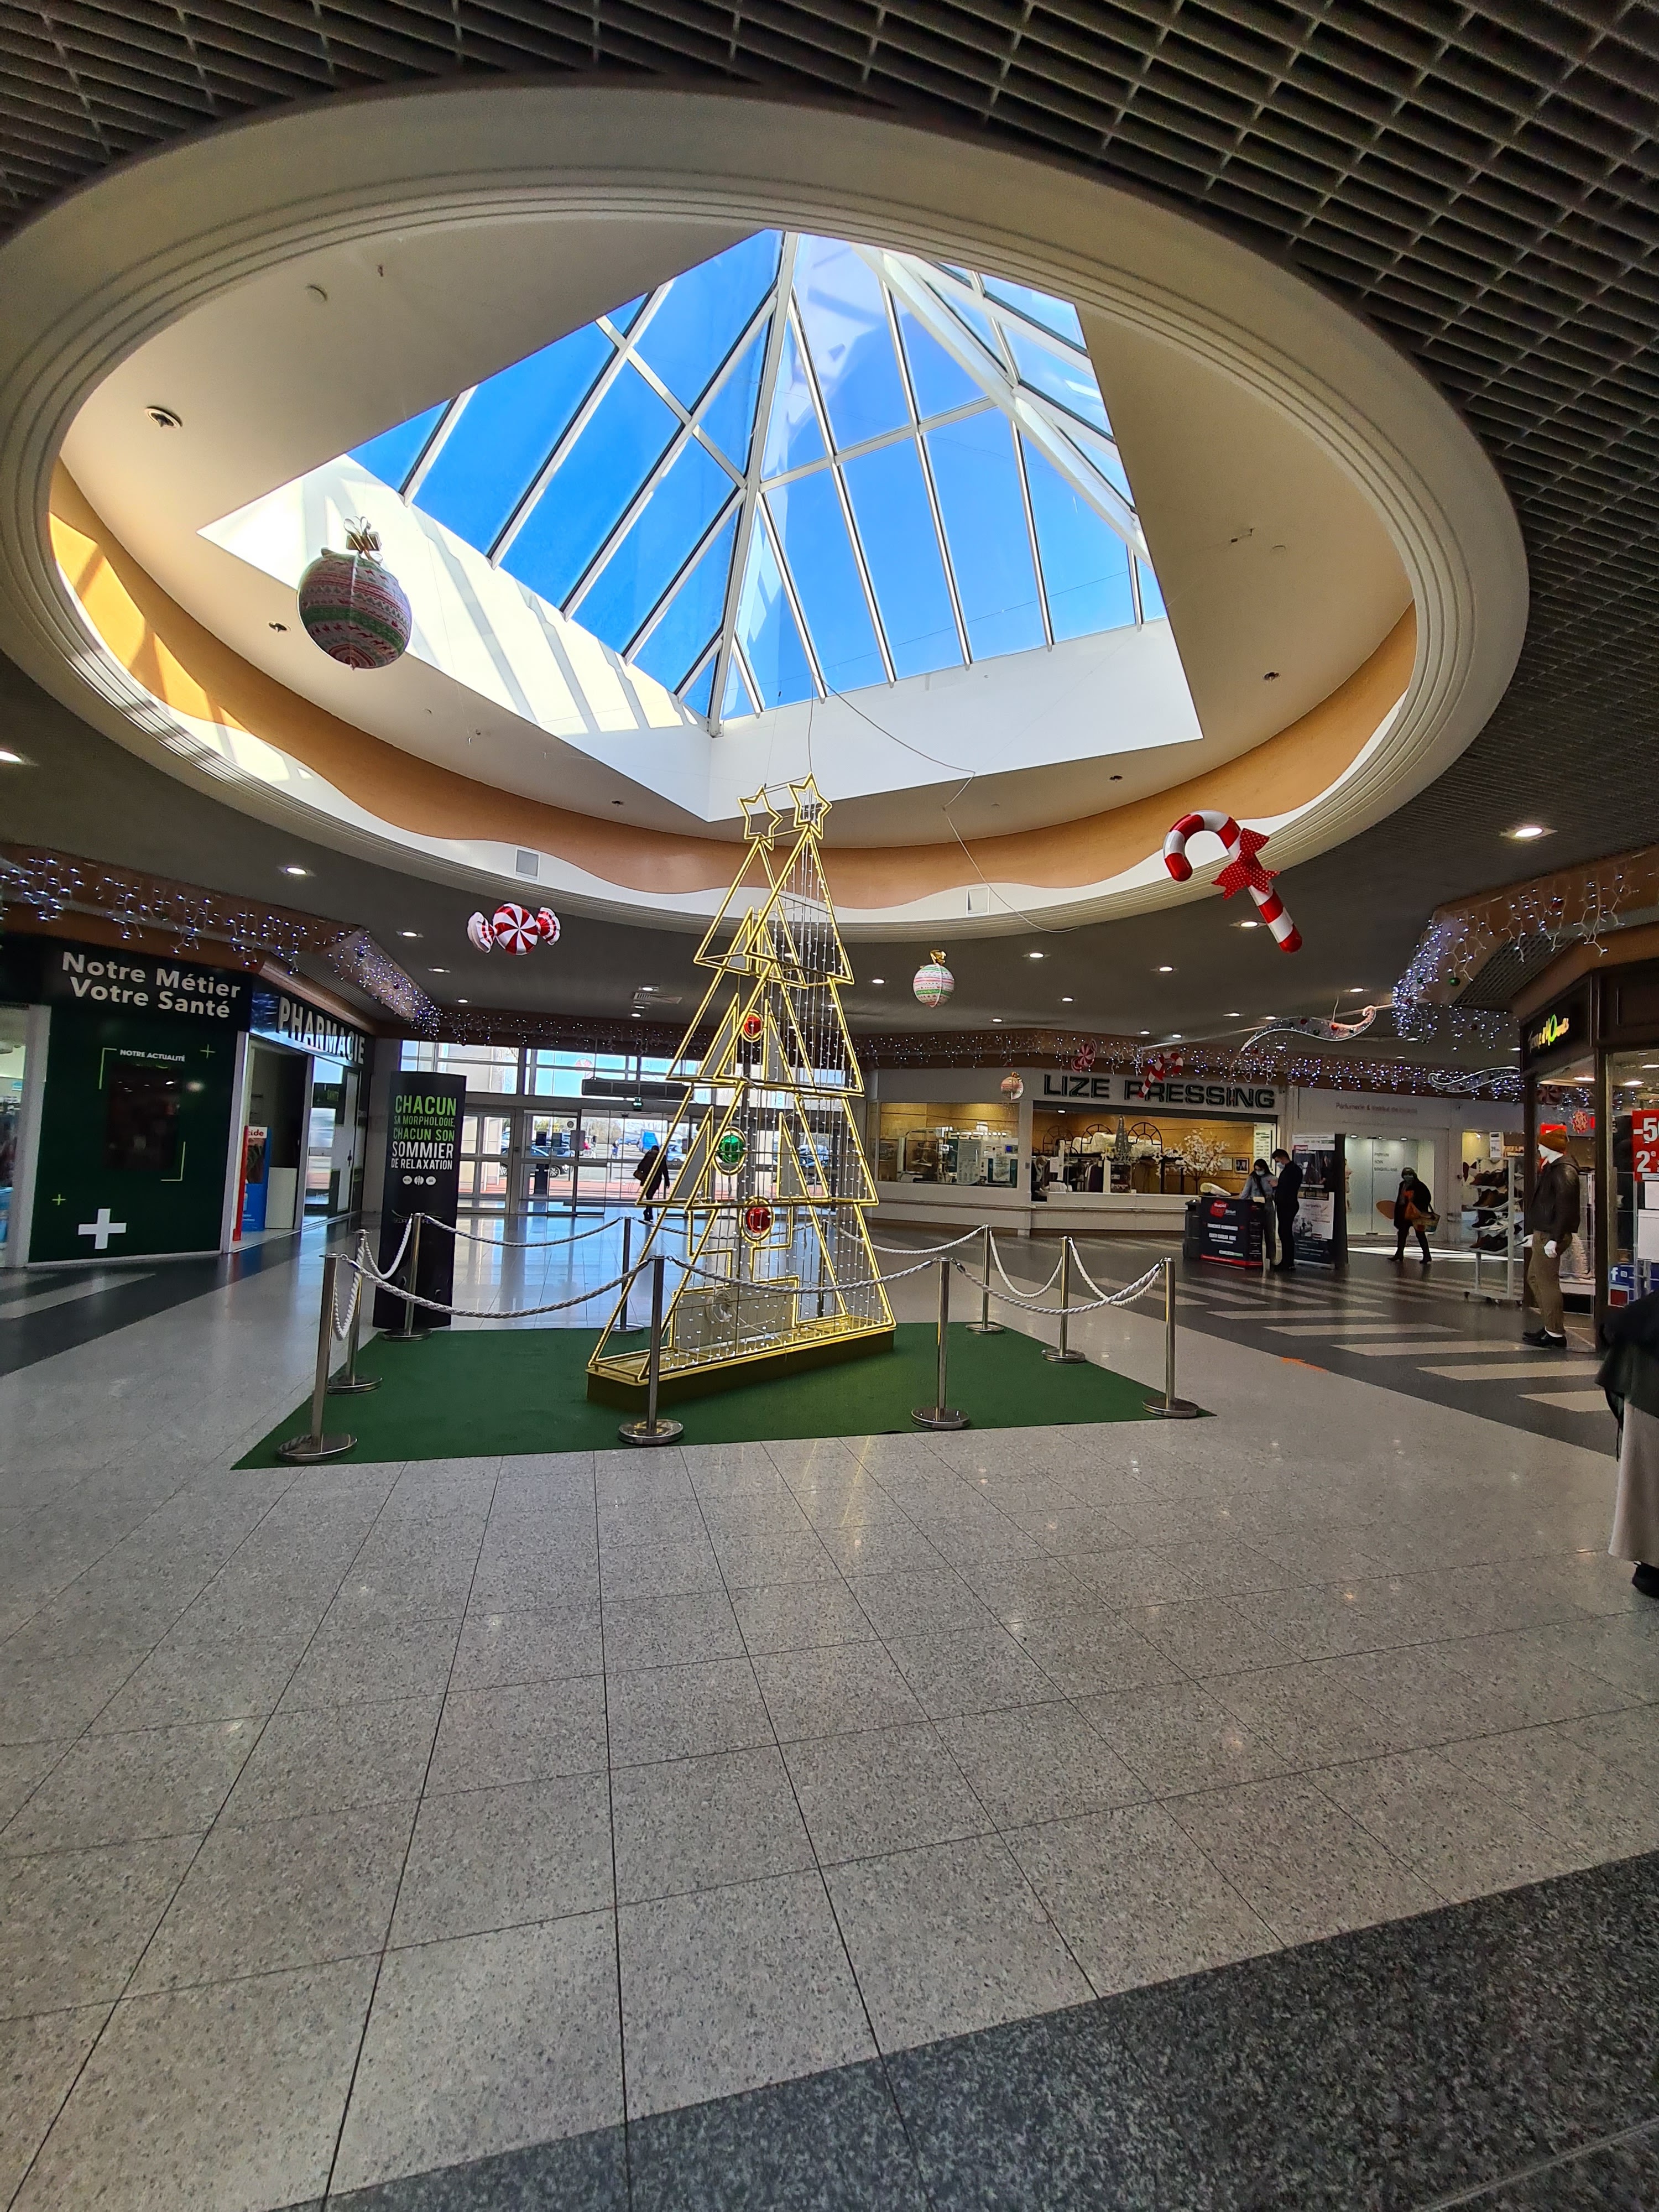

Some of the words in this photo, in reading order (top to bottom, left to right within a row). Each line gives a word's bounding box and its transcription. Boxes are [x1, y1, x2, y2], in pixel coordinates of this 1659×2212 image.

[62, 952, 145, 983] Notre
[156, 968, 241, 998] Métier
[70, 976, 149, 1006] Votre
[158, 991, 230, 1018] Santé
[278, 997, 366, 1065] PHARMACIE
[119, 1049, 145, 1058] NOTRE
[146, 1052, 185, 1062] ACTUALITÉ
[1044, 1074, 1110, 1099] LIZE
[1124, 1079, 1275, 1108] PRESSING
[395, 1095, 457, 1116] CHACUN
[394, 1115, 401, 1124] SA
[403, 1115, 456, 1128] MORPHOLOGIE,
[1633, 1117, 1659, 1142] -5
[393, 1128, 432, 1140] CHACUN
[435, 1129, 455, 1141] SON
[392, 1141, 454, 1159] SOMMIER
[391, 1158, 398, 1168] DE
[400, 1159, 453, 1170] RELAXATION
